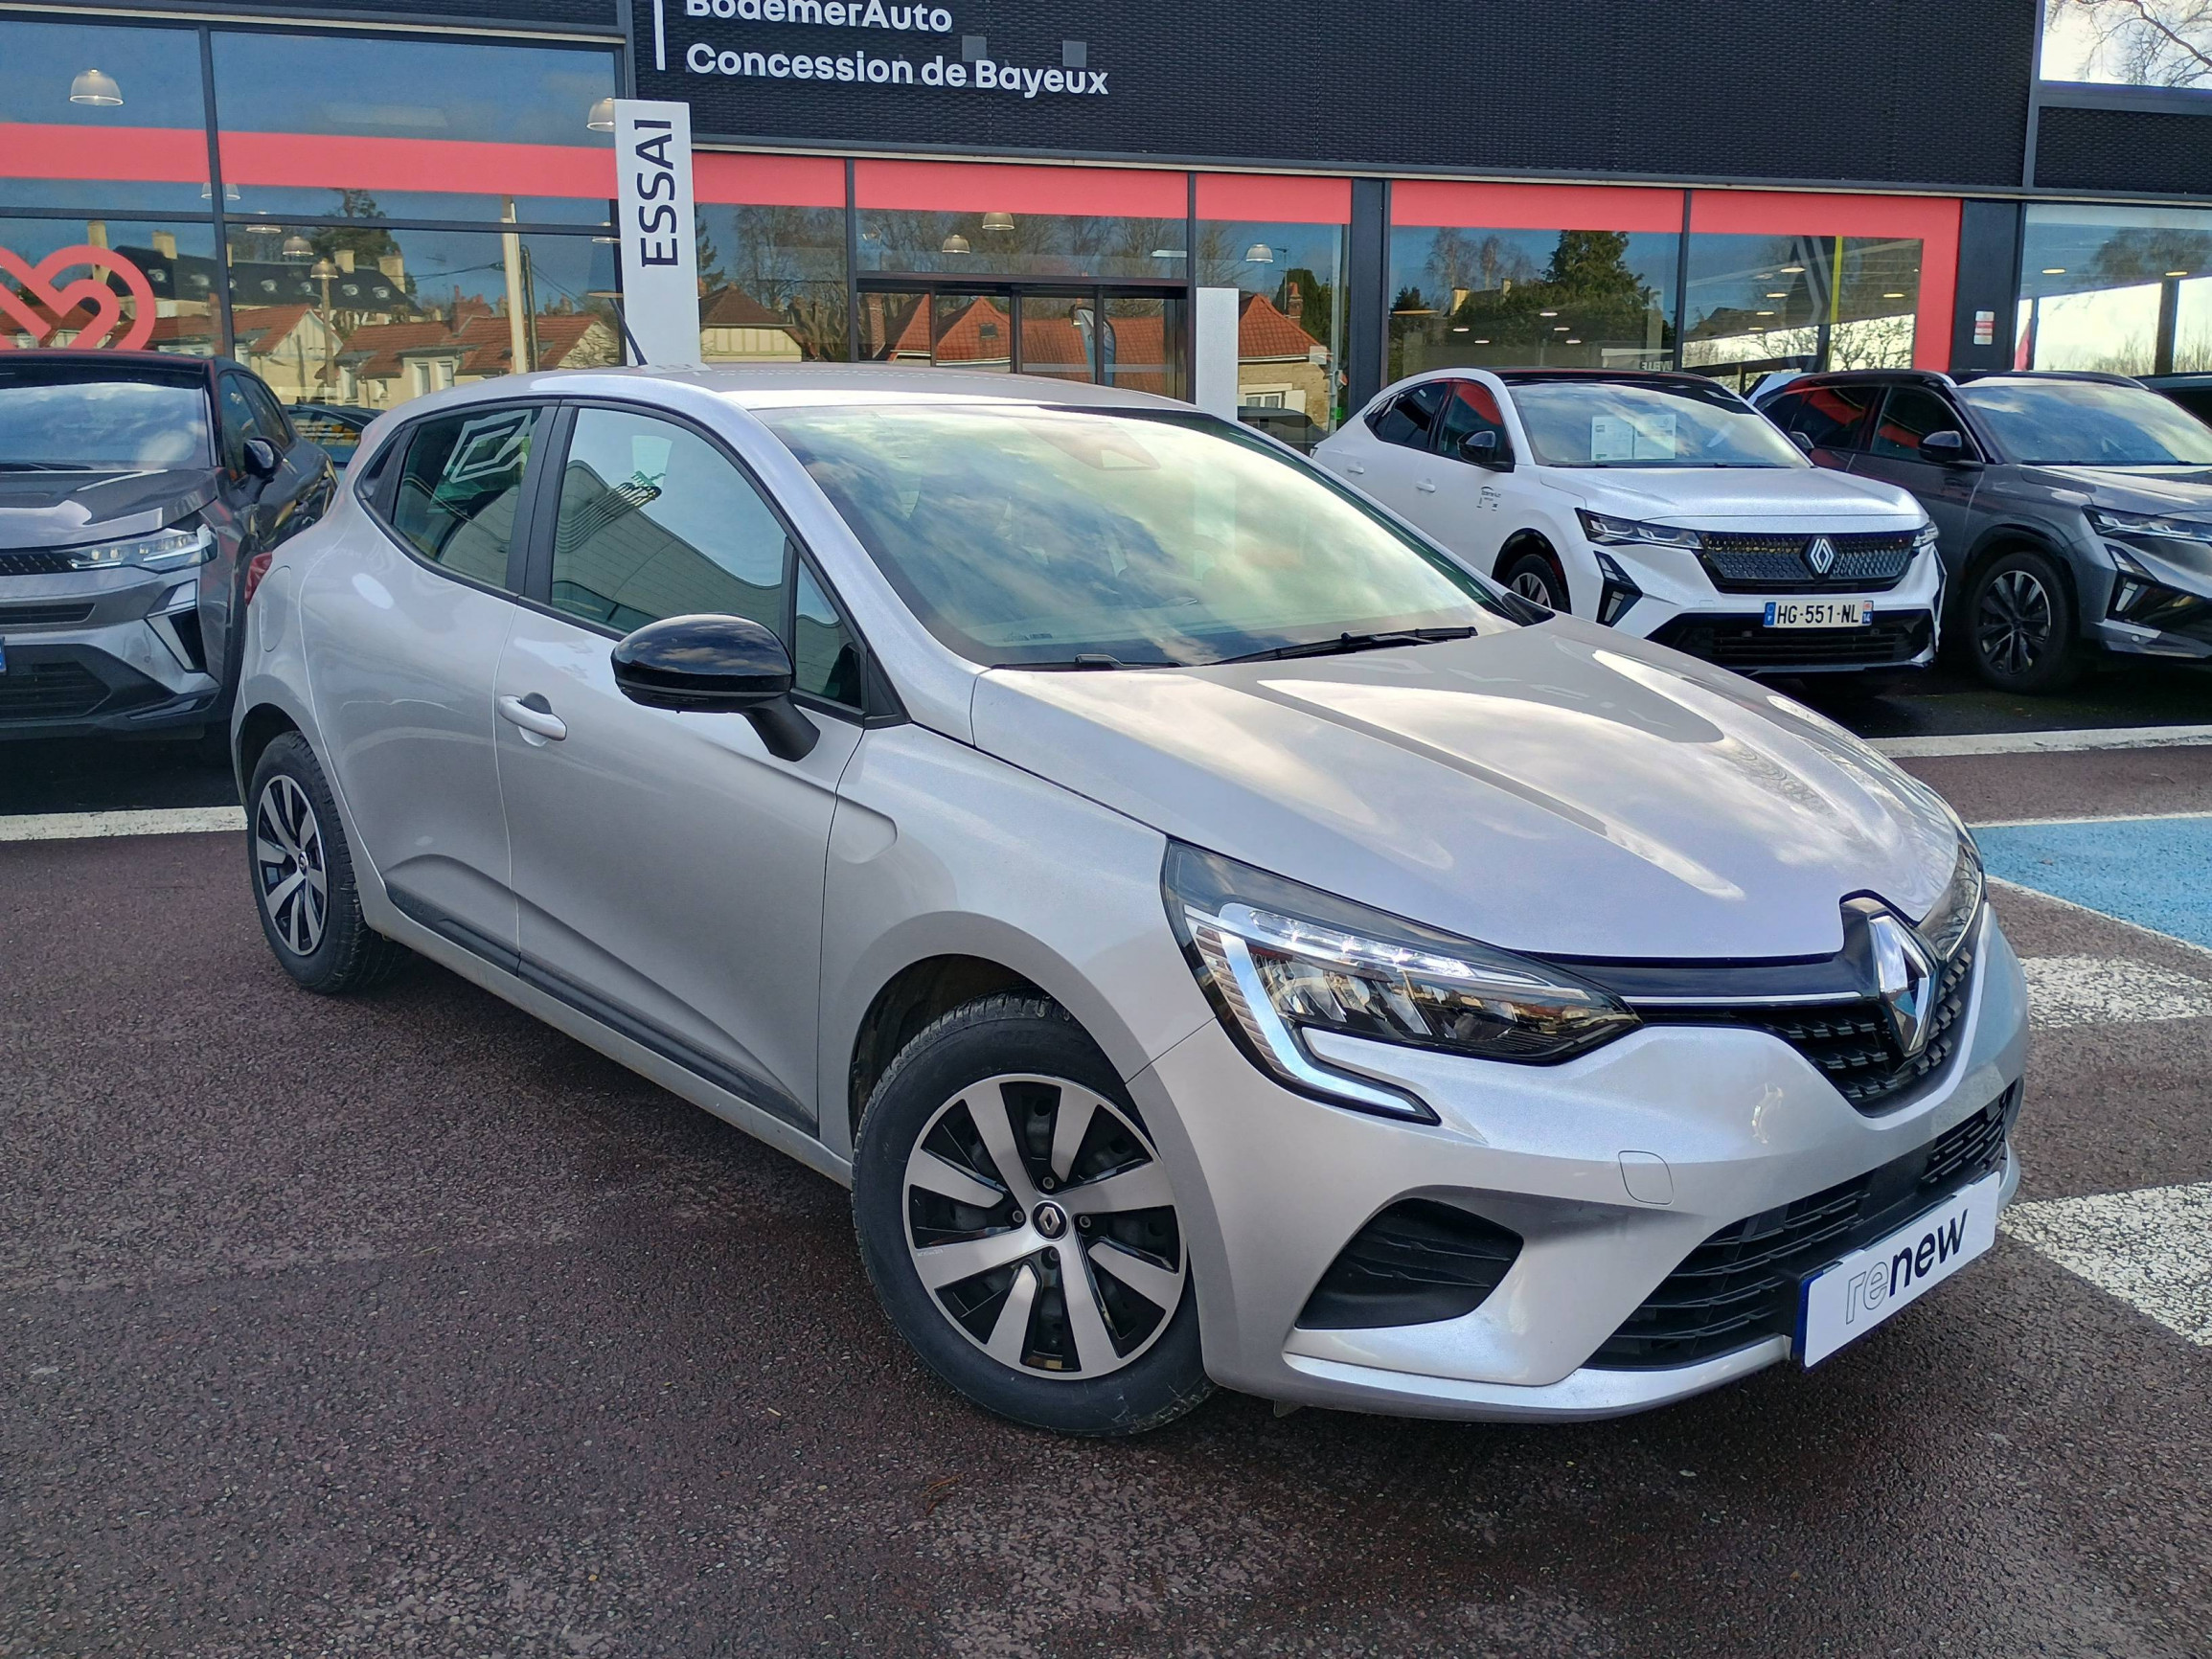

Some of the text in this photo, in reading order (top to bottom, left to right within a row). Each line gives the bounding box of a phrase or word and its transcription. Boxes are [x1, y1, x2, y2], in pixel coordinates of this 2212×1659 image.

[686, 0, 952, 32] BodemerAuto
[686, 42, 1109, 99] Concession de Bayeux
[633, 119, 678, 267] ESSAI
[1777, 604, 1859, 624] HG-551-NL
[1845, 1208, 1969, 1326] renew
